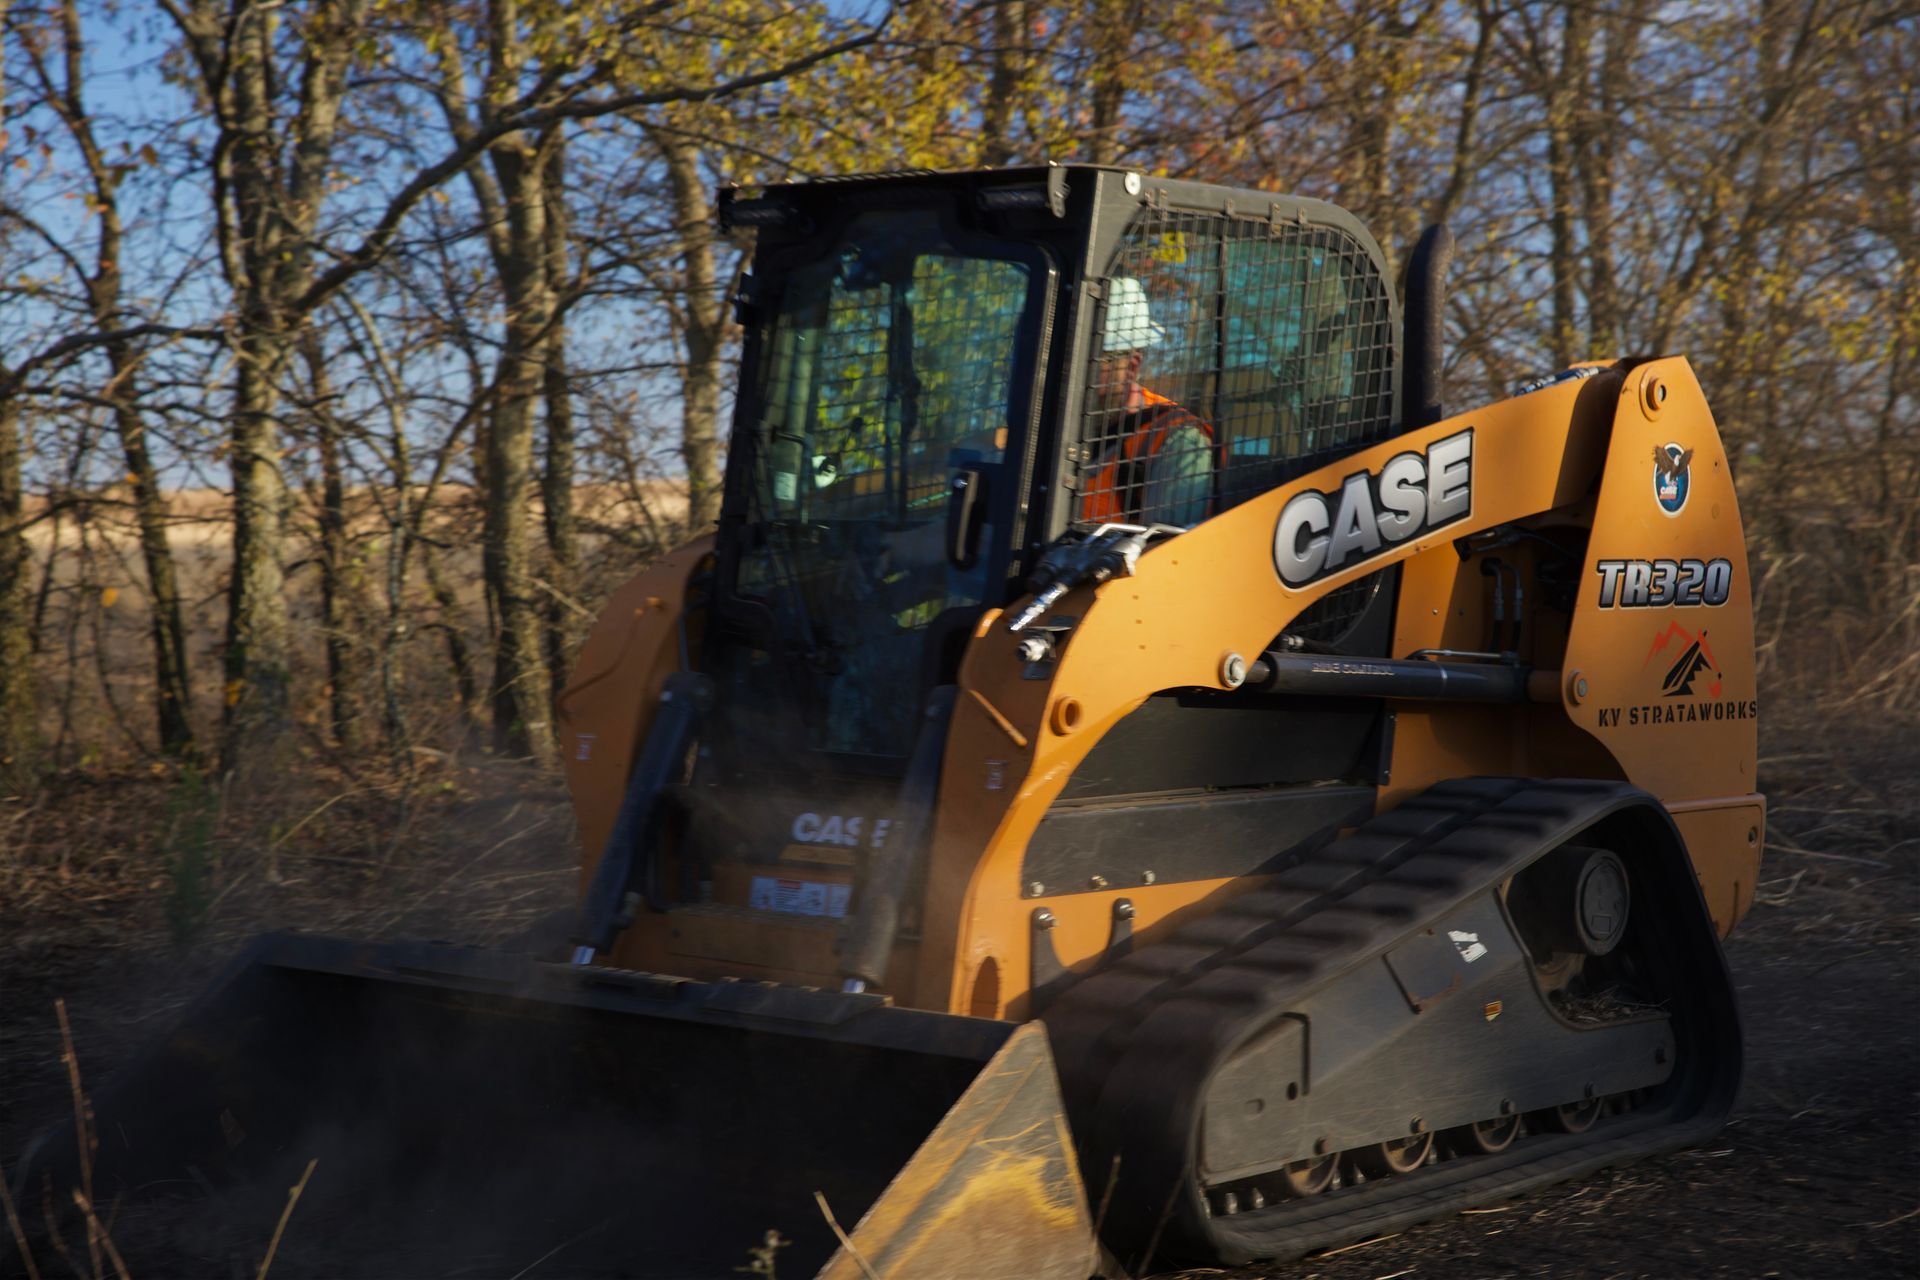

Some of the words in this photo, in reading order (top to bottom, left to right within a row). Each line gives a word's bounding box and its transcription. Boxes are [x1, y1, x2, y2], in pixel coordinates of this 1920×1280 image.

[1273, 428, 1473, 589] CASE
[1597, 559, 1732, 608] TR320
[1599, 708, 1620, 727] KV
[1629, 700, 1758, 725] STRATAWORKS
